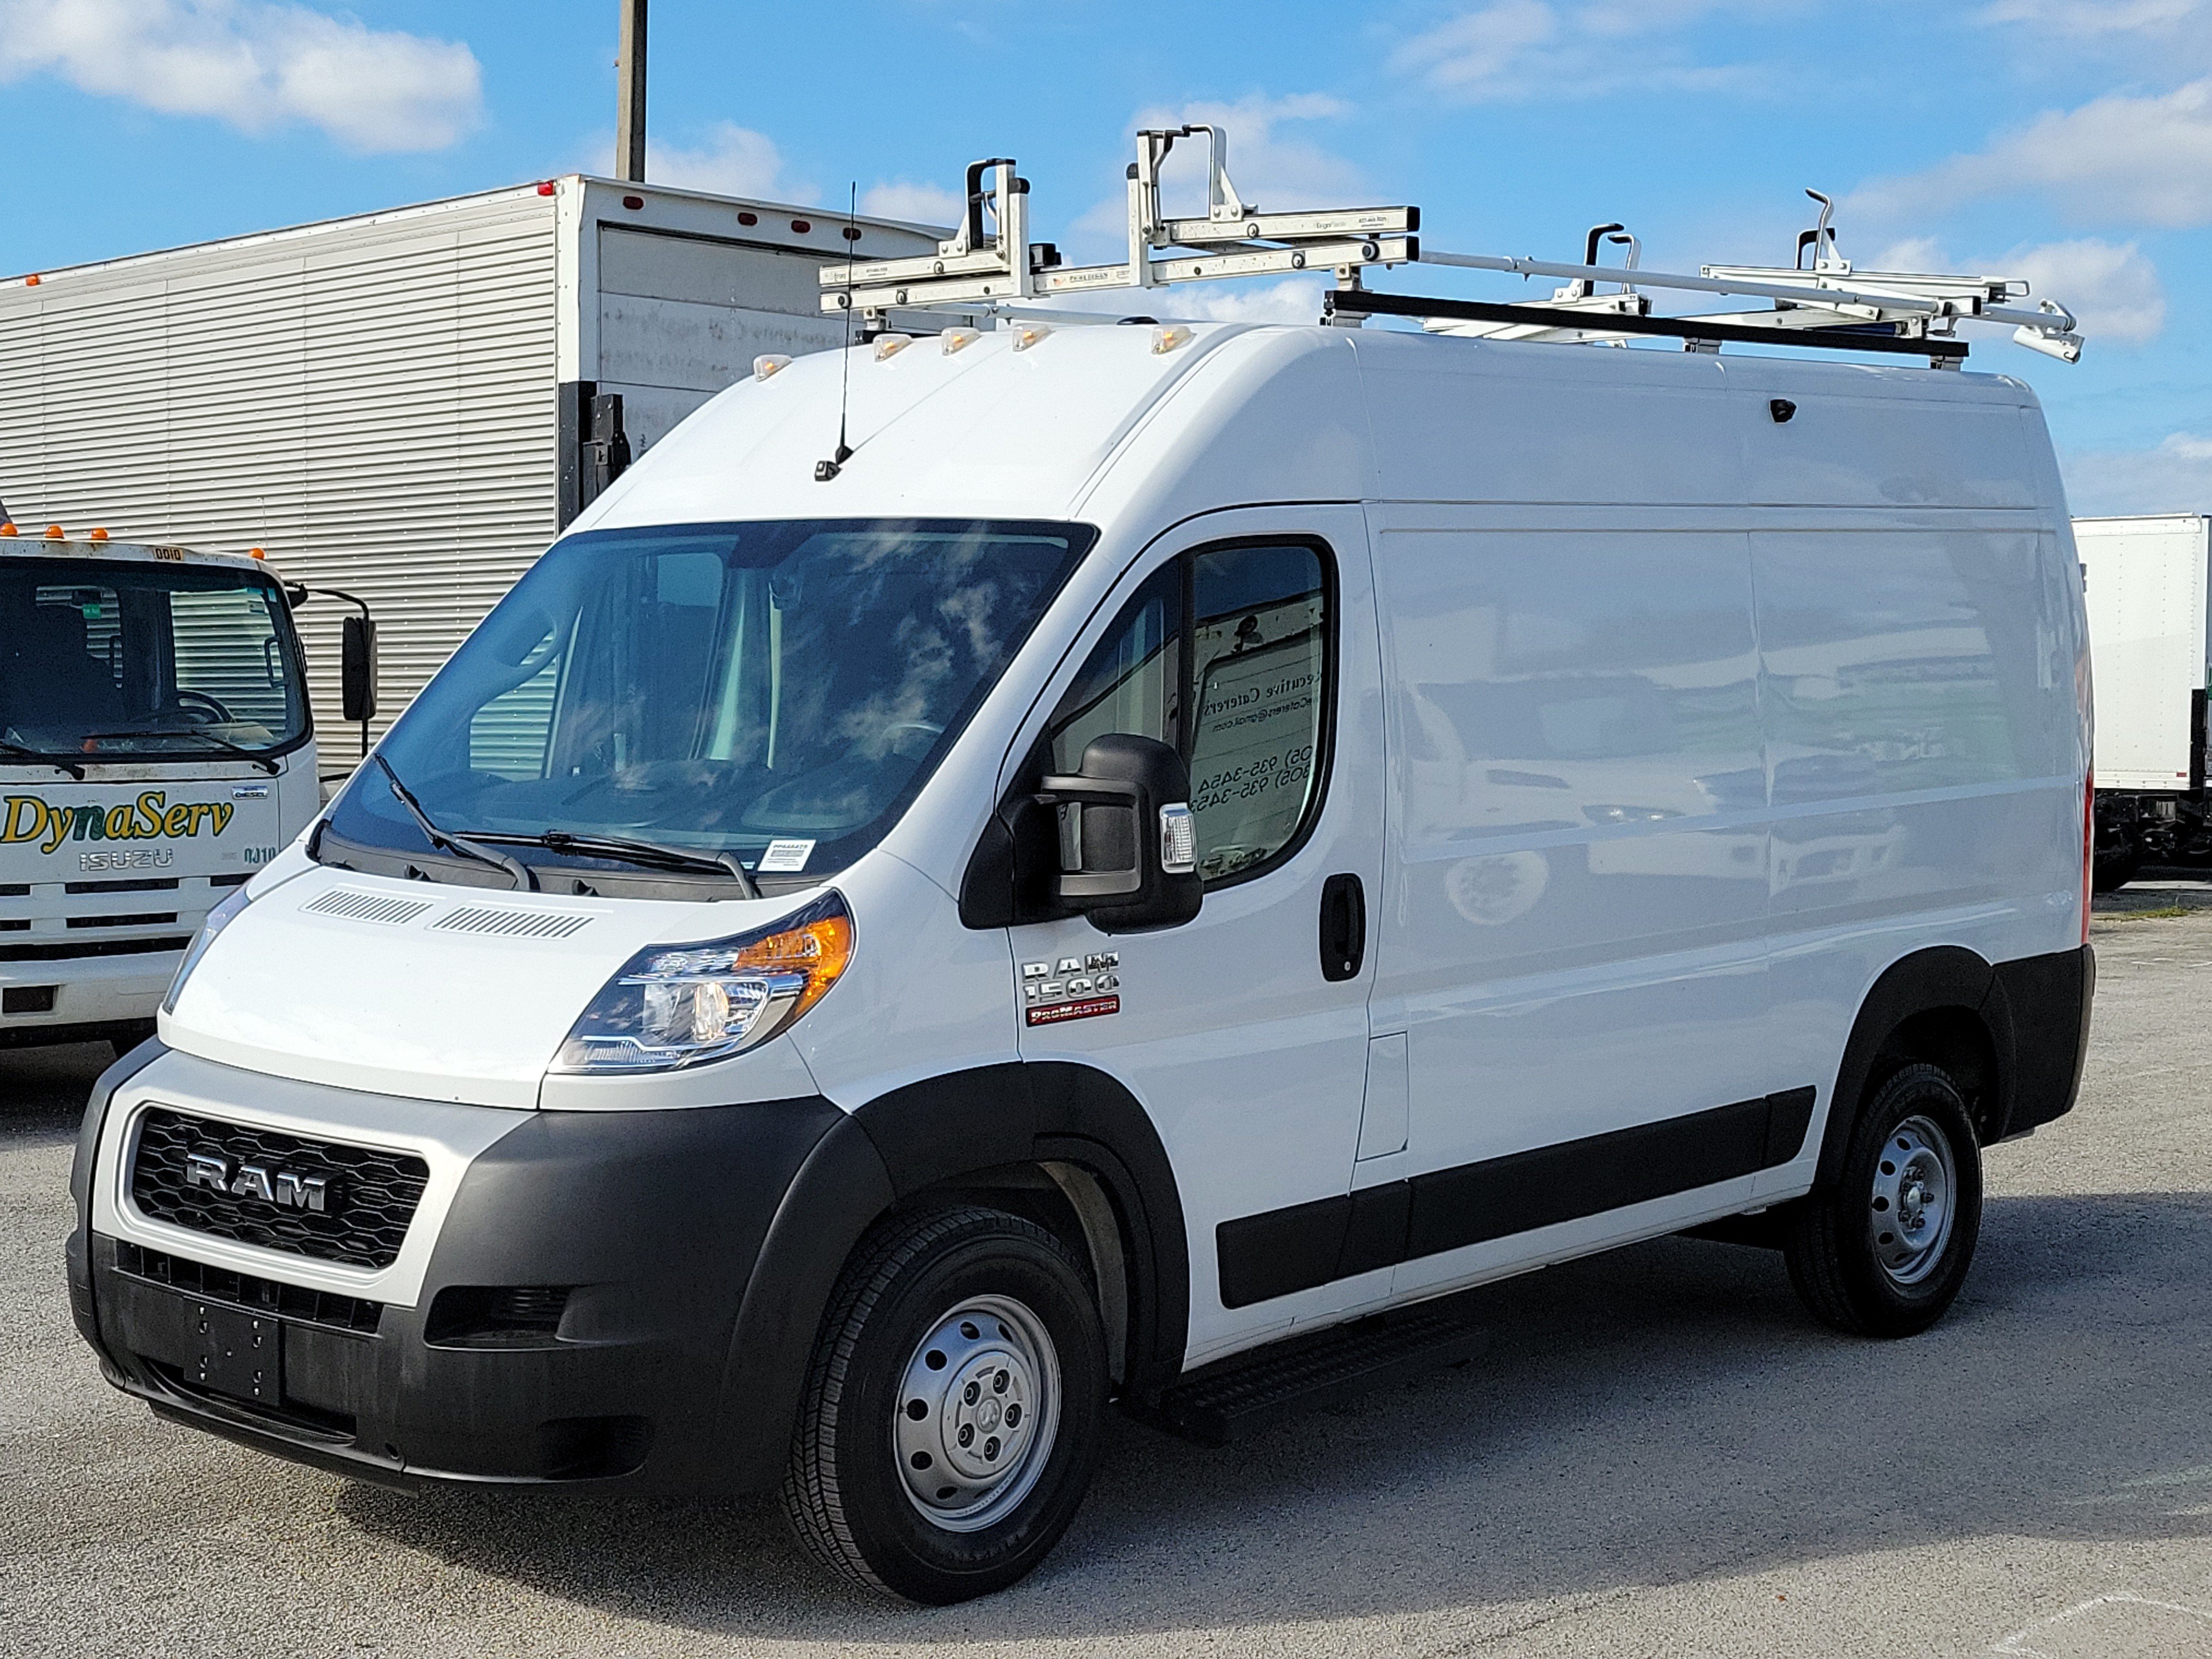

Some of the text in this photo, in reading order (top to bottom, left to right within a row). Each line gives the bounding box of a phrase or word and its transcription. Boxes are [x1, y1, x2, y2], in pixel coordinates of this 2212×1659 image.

[155, 548, 181, 560] 0010
[1, 791, 234, 855] DynaServ
[79, 849, 173, 872] ISUZU
[1022, 950, 1120, 983] RAM
[1023, 973, 1120, 1005] 1500
[187, 1153, 326, 1211] RAM
